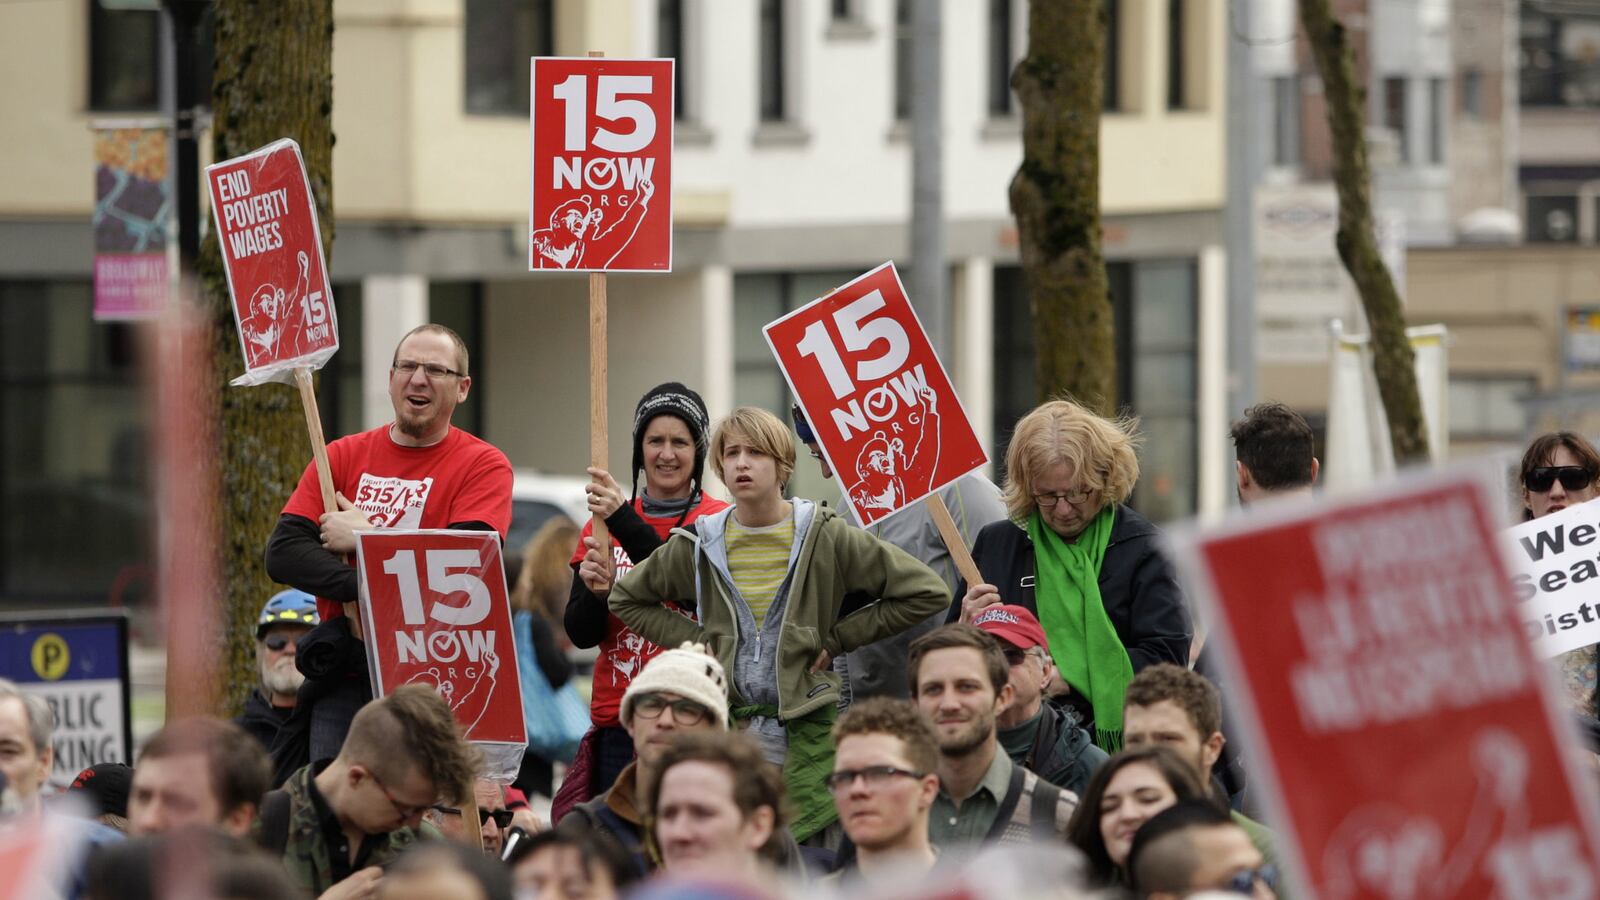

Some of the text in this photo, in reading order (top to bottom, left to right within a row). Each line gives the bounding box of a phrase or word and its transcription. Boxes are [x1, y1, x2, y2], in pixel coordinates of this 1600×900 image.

[553, 74, 657, 153] 15
[216, 169, 251, 202] END
[553, 156, 656, 191] NOW
[223, 187, 289, 231] POVERTY
[228, 220, 283, 260] WAGES
[300, 290, 326, 327] 15
[306, 322, 329, 343] NOW
[796, 288, 910, 400] 15
[830, 363, 927, 442] NOW
[1520, 522, 1600, 562] We
[382, 549, 492, 626] 15
[1510, 551, 1600, 604] Sea
[42, 643, 61, 673] P
[395, 630, 496, 663] NOW
